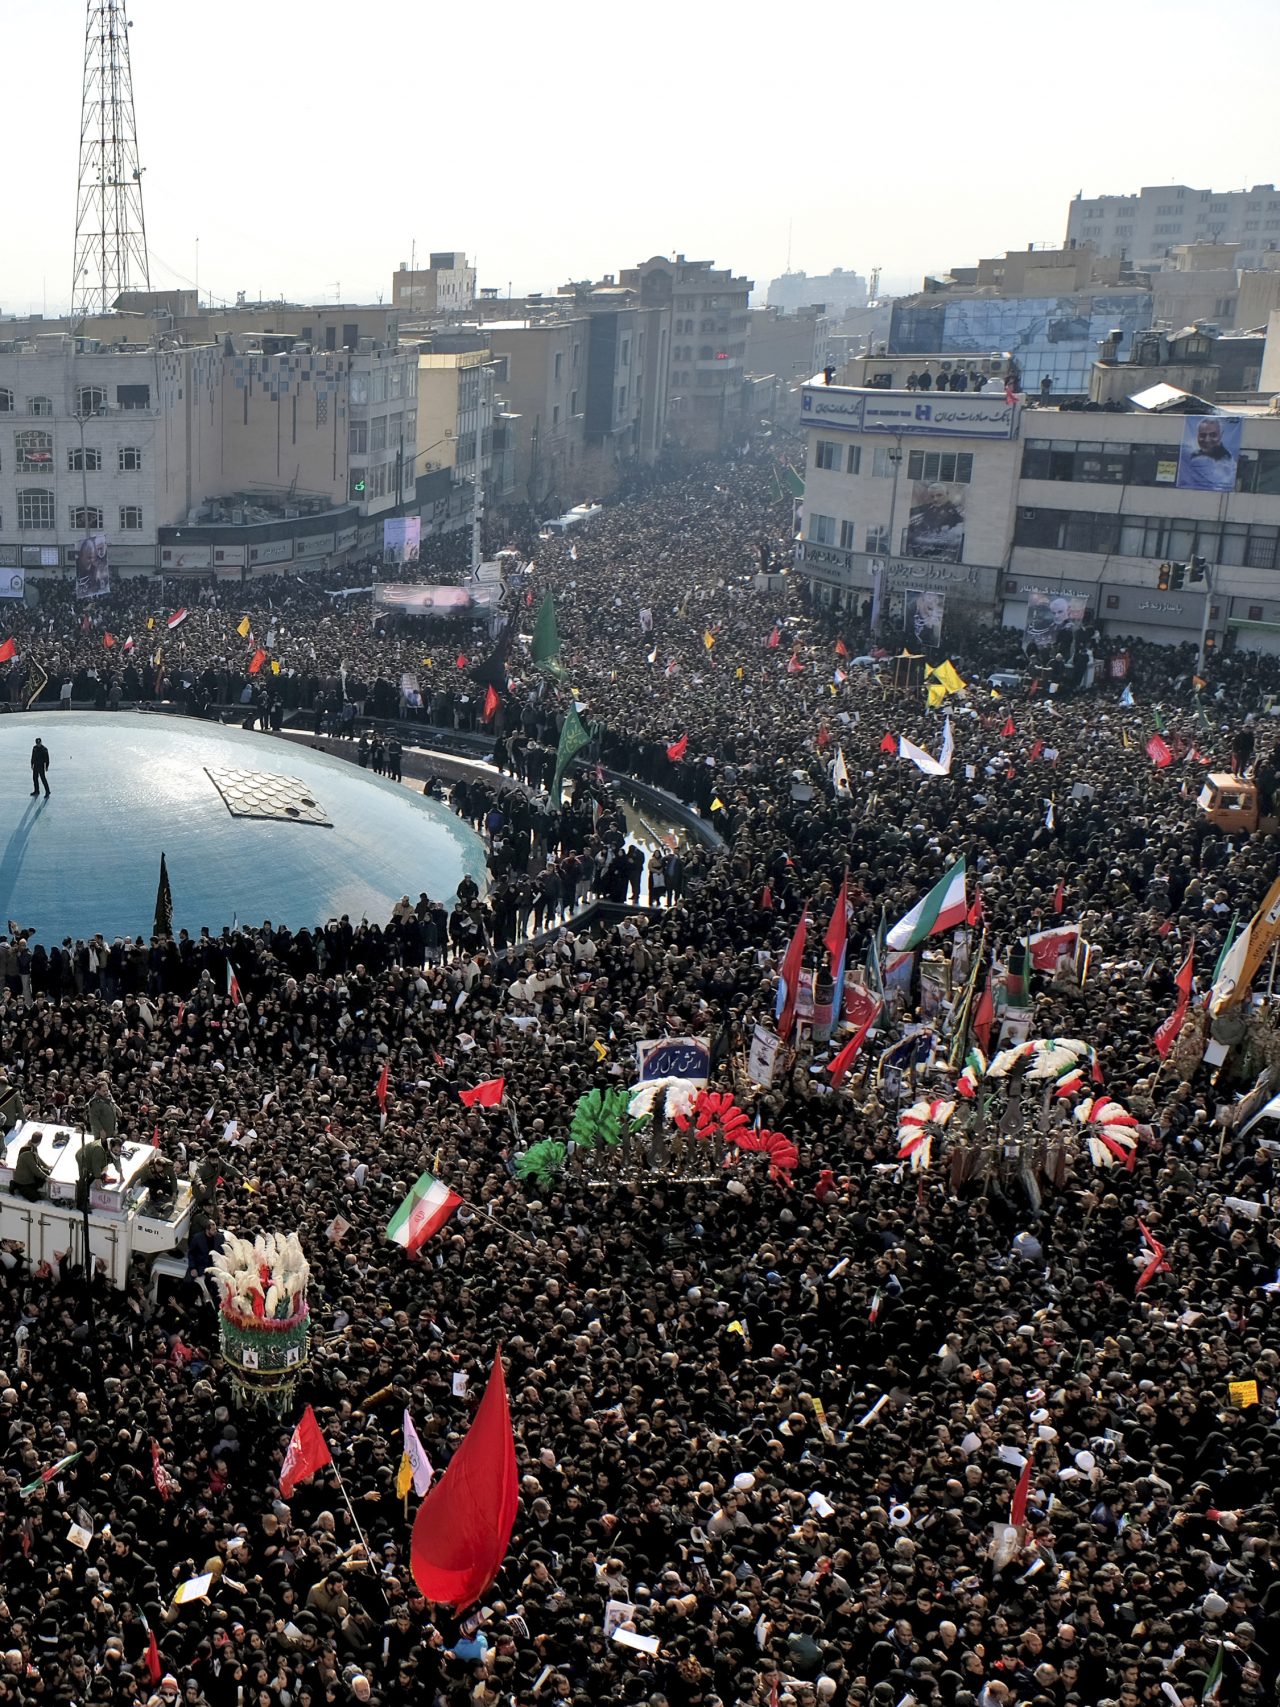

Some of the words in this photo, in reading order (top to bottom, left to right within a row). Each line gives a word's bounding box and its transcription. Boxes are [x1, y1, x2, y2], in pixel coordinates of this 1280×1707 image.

[934, 410, 960, 422] ایران
[960, 410, 988, 422] صادرات
[988, 408, 1011, 426] بانک
[888, 563, 913, 577] ایران
[912, 564, 952, 580] صادرات
[953, 566, 978, 585] بانک
[661, 1050, 680, 1073] تحول
[679, 1051, 701, 1072] ارتش
